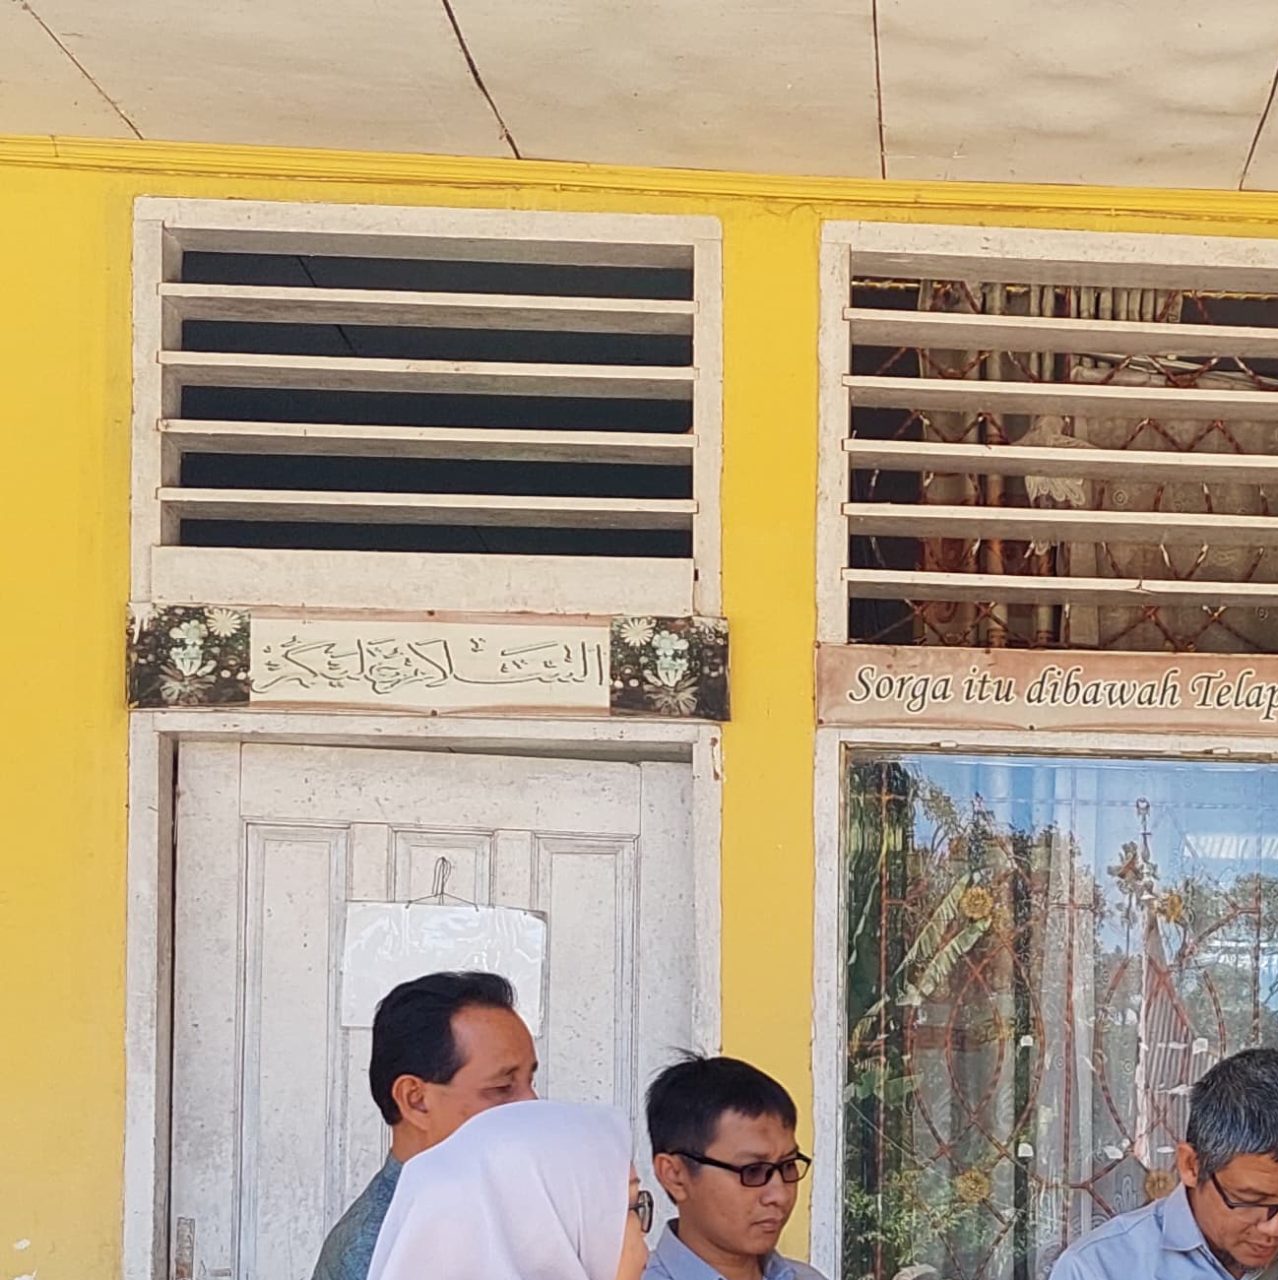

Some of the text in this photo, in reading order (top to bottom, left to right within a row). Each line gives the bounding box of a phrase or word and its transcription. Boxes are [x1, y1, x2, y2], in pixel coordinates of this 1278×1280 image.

[848, 666, 952, 713] Sorga
[963, 667, 1016, 702] itu
[1026, 667, 1182, 707] dibawah
